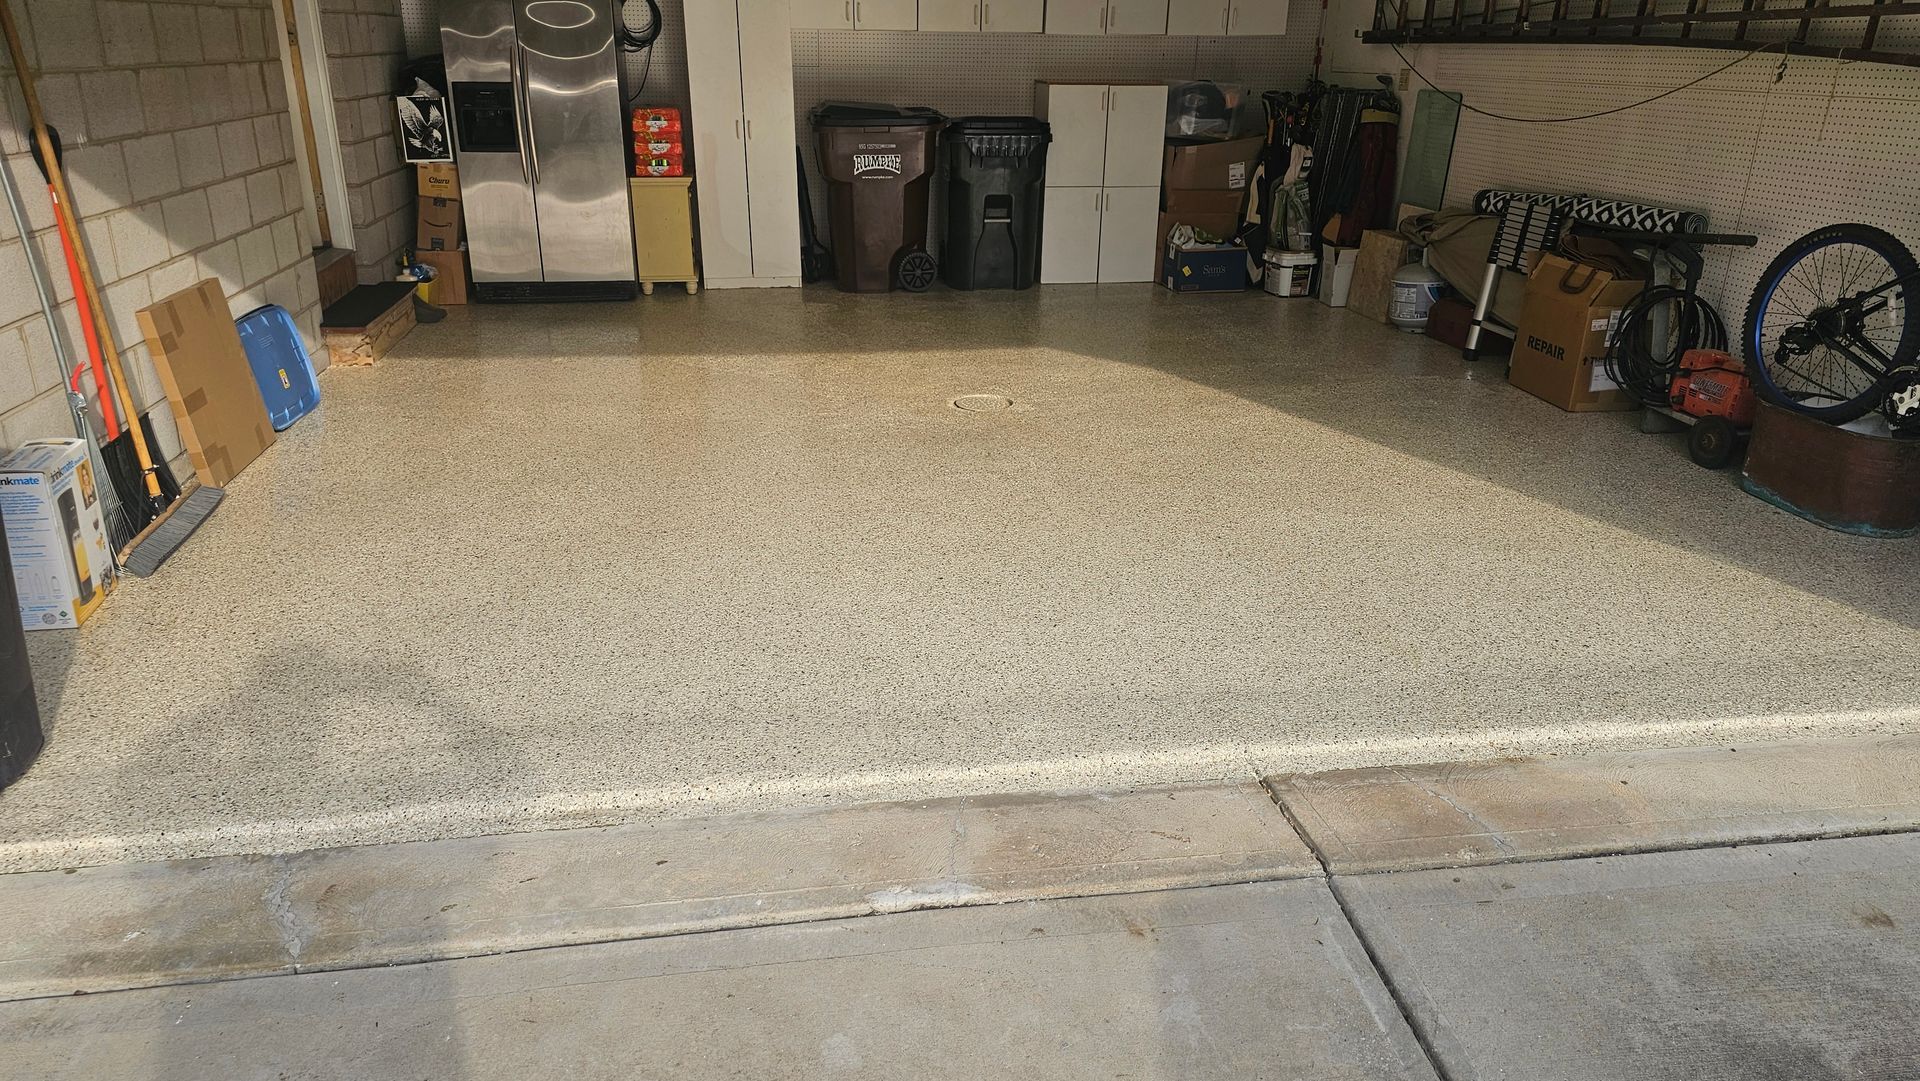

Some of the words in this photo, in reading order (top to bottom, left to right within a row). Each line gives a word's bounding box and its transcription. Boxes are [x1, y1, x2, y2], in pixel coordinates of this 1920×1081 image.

[853, 154, 902, 175] RUMPKE
[428, 176, 450, 185] Churu
[1202, 264, 1226, 274] Sam's
[1526, 335, 1566, 361] REPAIR
